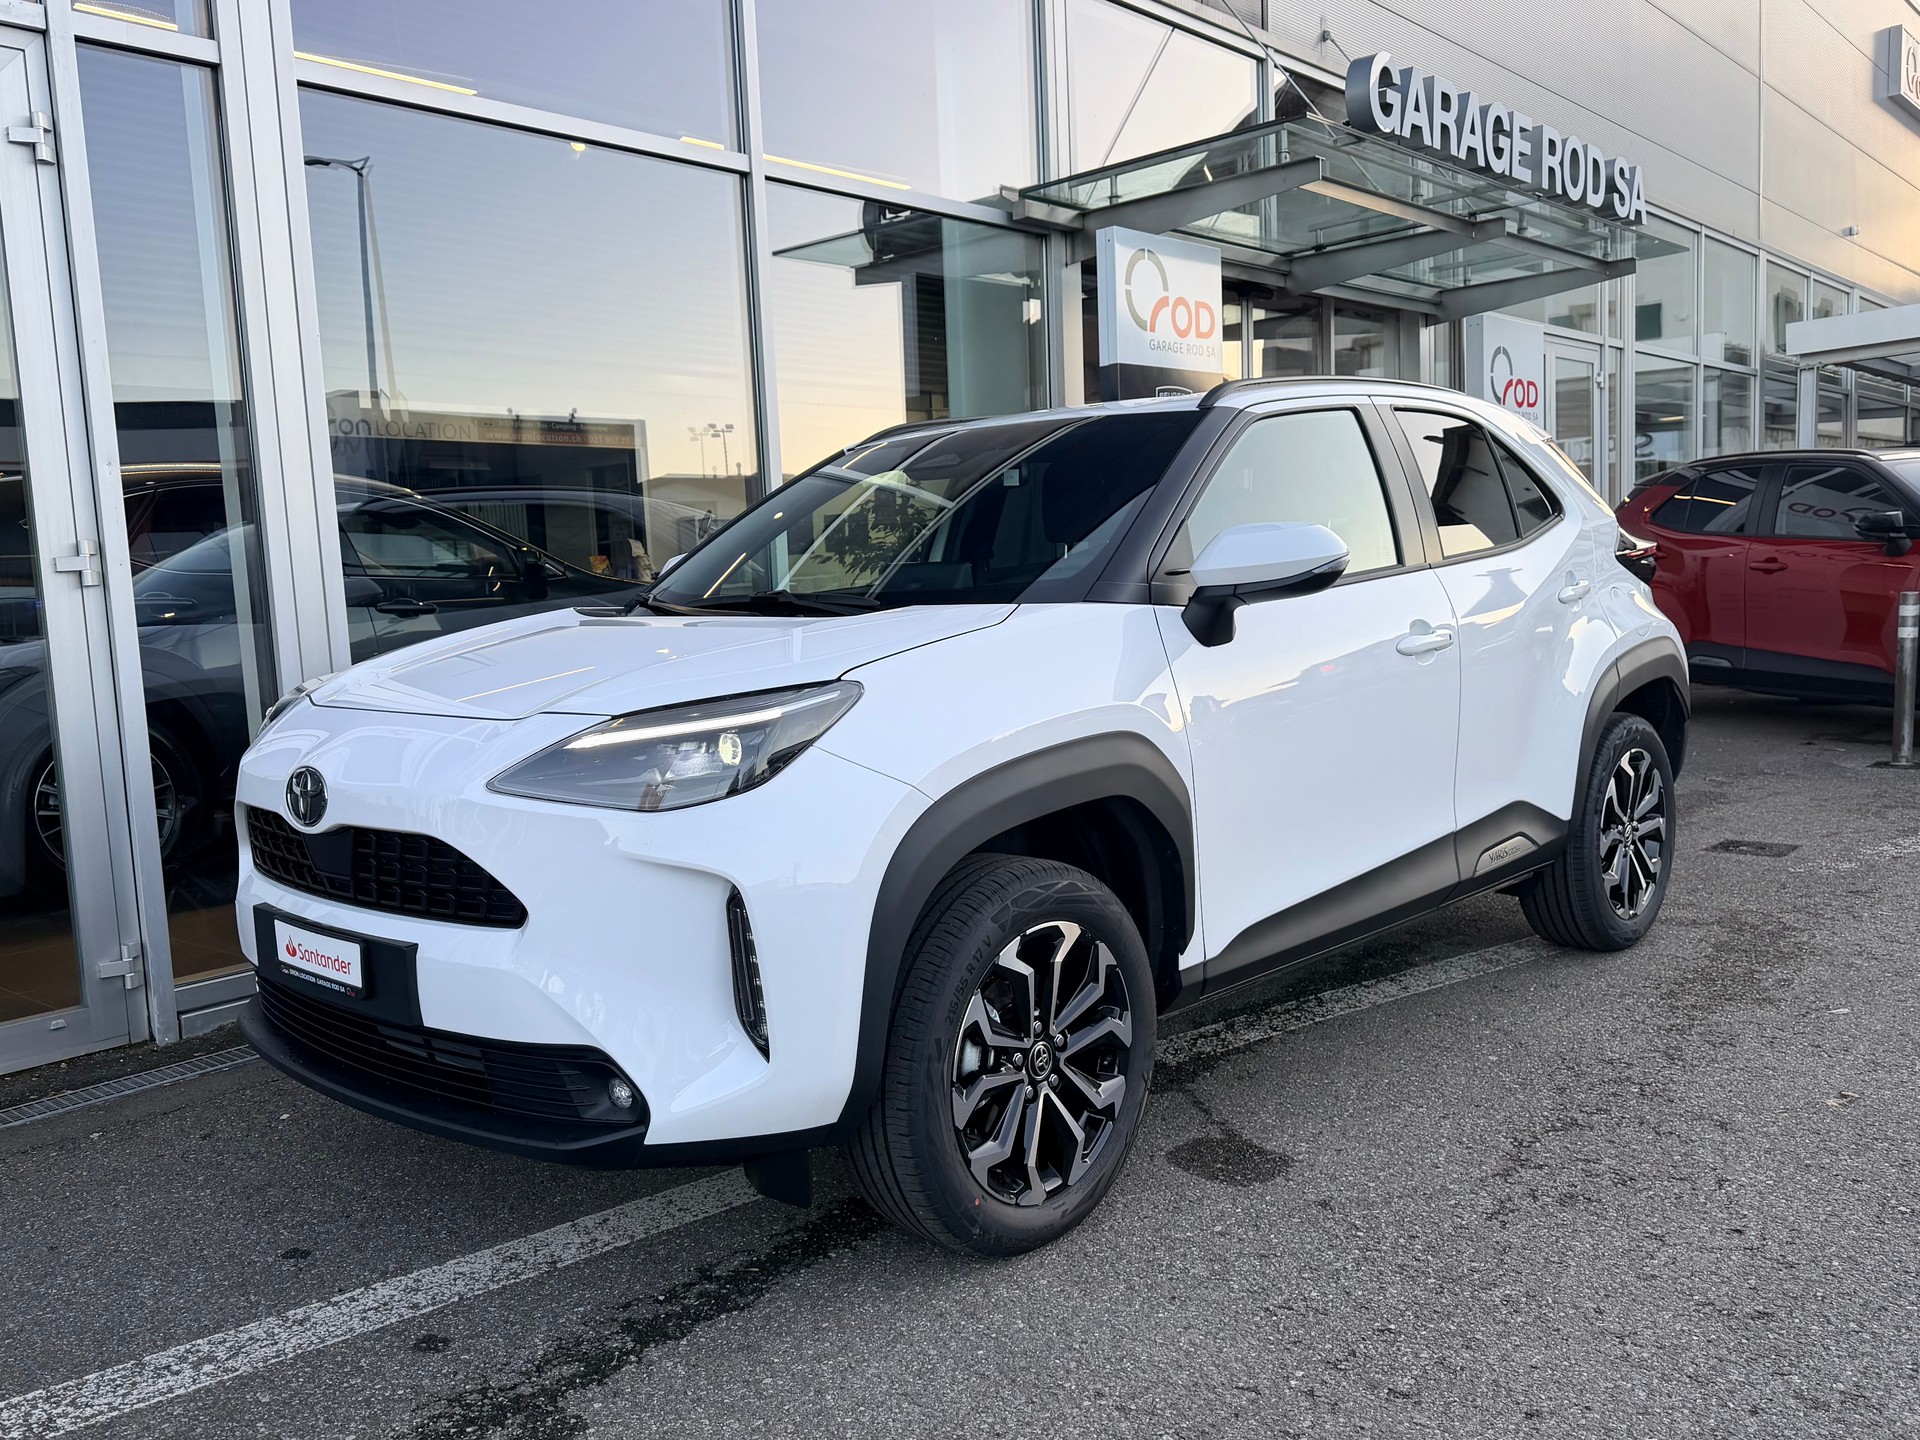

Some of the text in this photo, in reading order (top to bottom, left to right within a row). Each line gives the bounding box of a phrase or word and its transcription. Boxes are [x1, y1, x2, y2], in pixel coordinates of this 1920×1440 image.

[1369, 51, 1648, 226] GARAGE ROD SA
[1149, 339, 1216, 358] GARAGE ROD SA
[376, 419, 471, 440] LOCATION
[486, 430, 582, 444] www.oronlocation.ch
[298, 943, 351, 975] Santander
[944, 975, 969, 1027] 215/55
